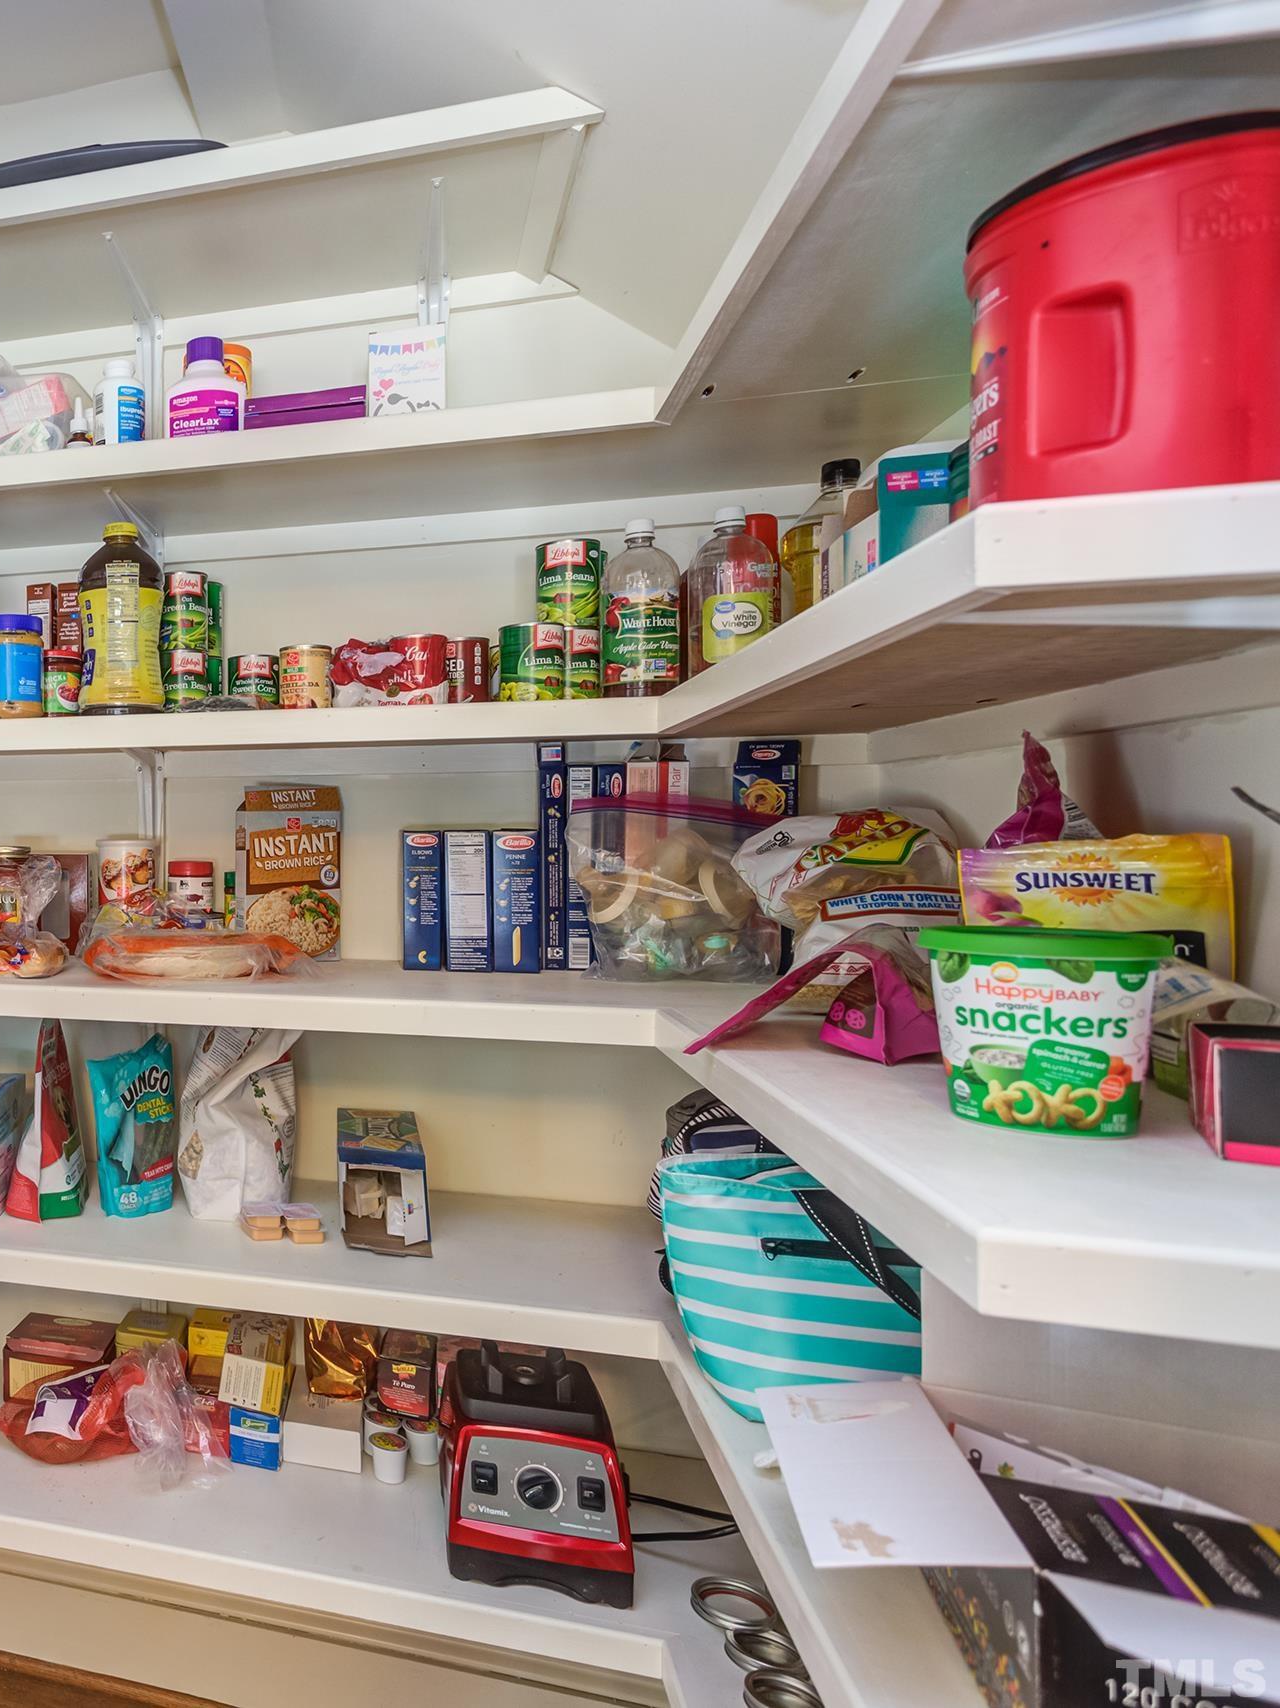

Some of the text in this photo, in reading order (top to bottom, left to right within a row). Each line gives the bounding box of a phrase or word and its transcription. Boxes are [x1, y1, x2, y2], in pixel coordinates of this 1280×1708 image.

[173, 395, 198, 404] amazon
[173, 417, 220, 430] ClearLax
[551, 546, 580, 560] Libby's
[539, 574, 563, 586] Lima
[565, 572, 595, 582] Beans
[622, 617, 652, 629] WHITE
[733, 613, 757, 621] White
[722, 620, 757, 628] Vinegar
[541, 630, 564, 642] Libby
[577, 634, 599, 646] Libby
[612, 641, 659, 654] Apple Cider
[524, 656, 552, 666] Lima
[281, 674, 308, 683] RED
[257, 684, 278, 694] Corn
[271, 789, 317, 803] INSTANT
[253, 831, 337, 858] INSTANT
[412, 836, 436, 844] Barilla
[505, 838, 532, 847] Barilla
[793, 820, 914, 873] CALID
[264, 855, 326, 870] BROWN RICE
[1014, 871, 1156, 895] SUNSWEET
[828, 895, 868, 908] WHITE
[870, 893, 904, 902] CORN
[856, 901, 942, 910] TOTOPOS DE MAIZ
[995, 1001, 1040, 1011] organic
[954, 1004, 1129, 1039] snackers
[1032, 1047, 1071, 1063] spinach
[1079, 1056, 1107, 1070] carrot
[1054, 1045, 1092, 1060] creamy
[1040, 1061, 1094, 1078] GLUTEN FREE
[120, 1064, 171, 1111] DINGO
[136, 1097, 167, 1113] DENTAL
[120, 1192, 138, 1204] 48
[400, 1381, 416, 1390] Puro
[478, 1504, 508, 1517] Vitamix
